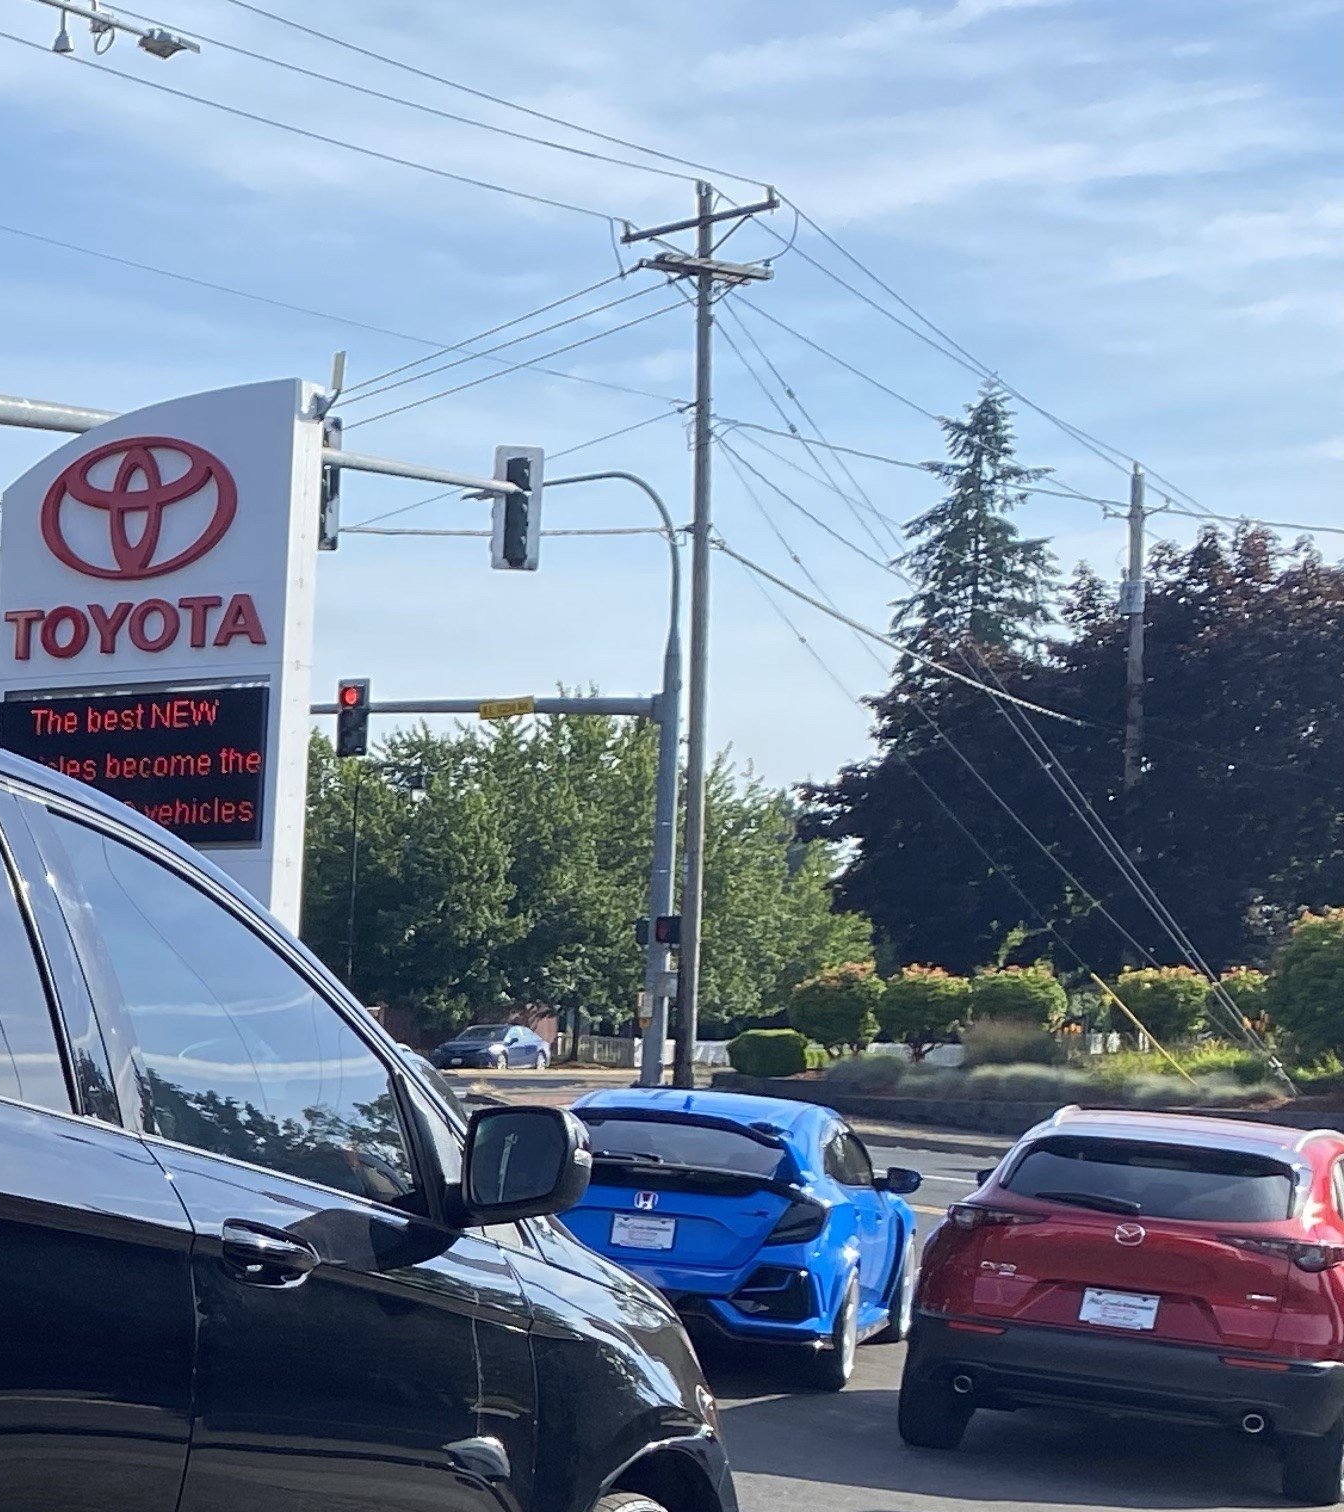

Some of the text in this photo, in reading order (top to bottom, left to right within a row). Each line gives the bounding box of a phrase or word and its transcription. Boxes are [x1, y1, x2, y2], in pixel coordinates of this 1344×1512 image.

[4, 593, 267, 661] TOYOTA
[30, 698, 220, 736] The best NEW
[105, 752, 211, 779] become
[218, 747, 262, 774] the
